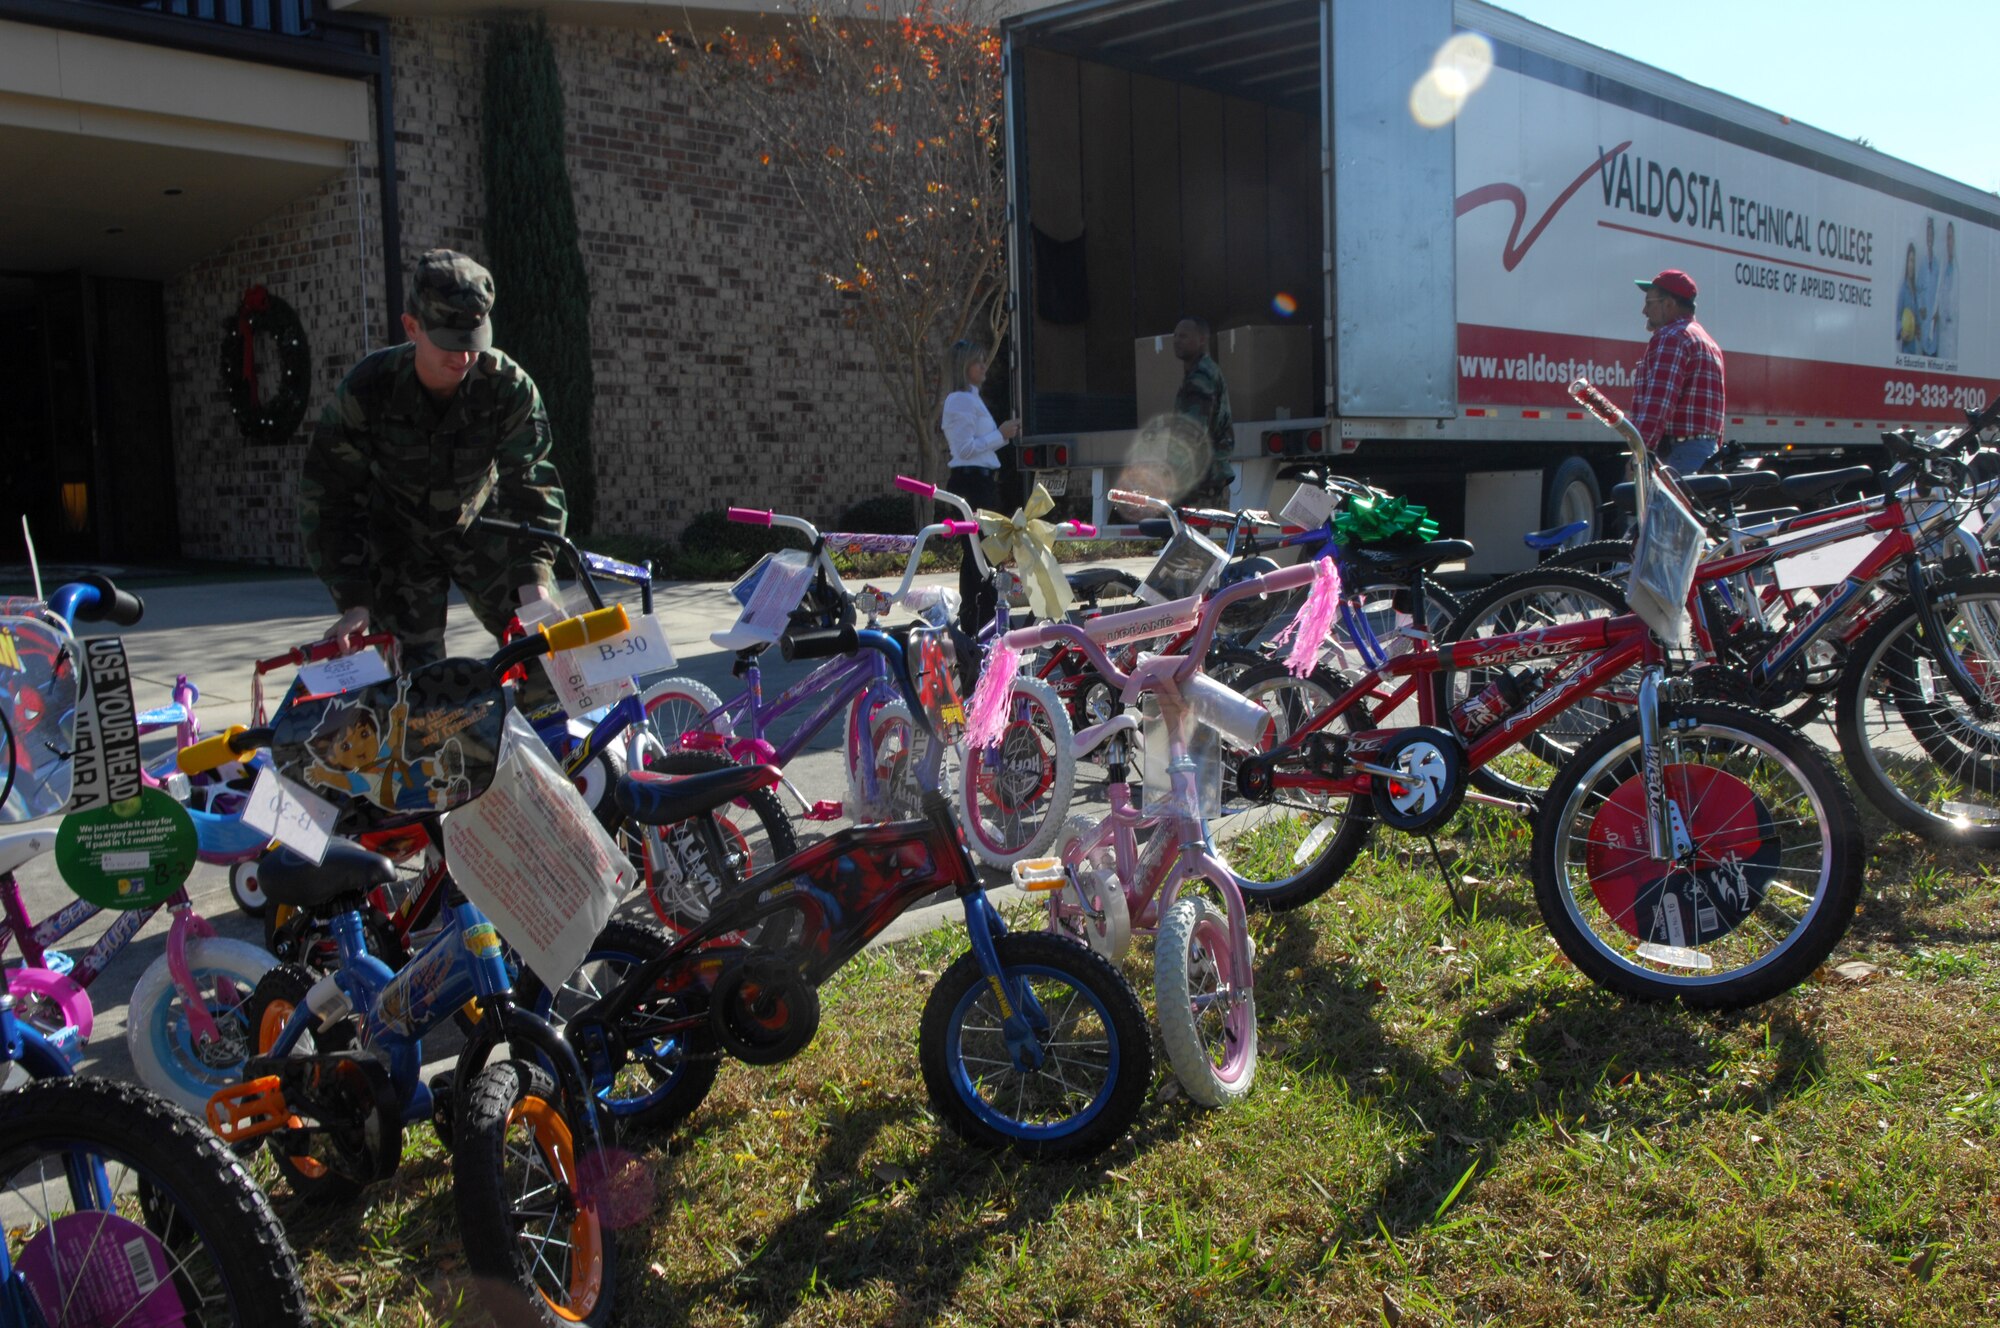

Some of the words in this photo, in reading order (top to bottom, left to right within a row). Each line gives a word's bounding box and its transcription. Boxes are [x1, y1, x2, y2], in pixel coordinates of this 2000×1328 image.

[1598, 145, 1725, 233] VALDOSTA
[1729, 196, 1812, 253] TECHNICAL
[1817, 219, 1873, 266] COLLEGE
[1735, 262, 1779, 291] COLLEGE
[1784, 272, 1798, 294] OF
[1801, 277, 1835, 301] APPLIED
[1838, 283, 1872, 308] SCIENCE
[1884, 380, 1986, 409] 229-333-2100
[1107, 617, 1175, 641] UPLAND
[1766, 579, 1850, 664] PACIFIC
[88, 640, 127, 684] USE
[598, 635, 648, 661] B-30
[568, 673, 594, 710] B-19
[96, 684, 135, 745] YOUR
[106, 745, 140, 801] HEAD
[70, 790, 100, 812] A
[268, 795, 313, 832] B-30
[77, 833, 93, 844] you
[93, 832, 103, 841] to
[103, 831, 127, 842] enjoy
[127, 828, 146, 838] zero
[146, 824, 177, 835] interest
[79, 825, 93, 834] We
[93, 824, 110, 834] just
[110, 821, 134, 831] made
[134, 820, 141, 828] it
[141, 818, 160, 828] easy
[161, 816, 173, 826] for
[85, 841, 92, 850] if
[92, 840, 111, 851] paid
[111, 838, 120, 847] in
[123, 837, 132, 846] 12
[1729, 849, 1751, 912] NEXT
